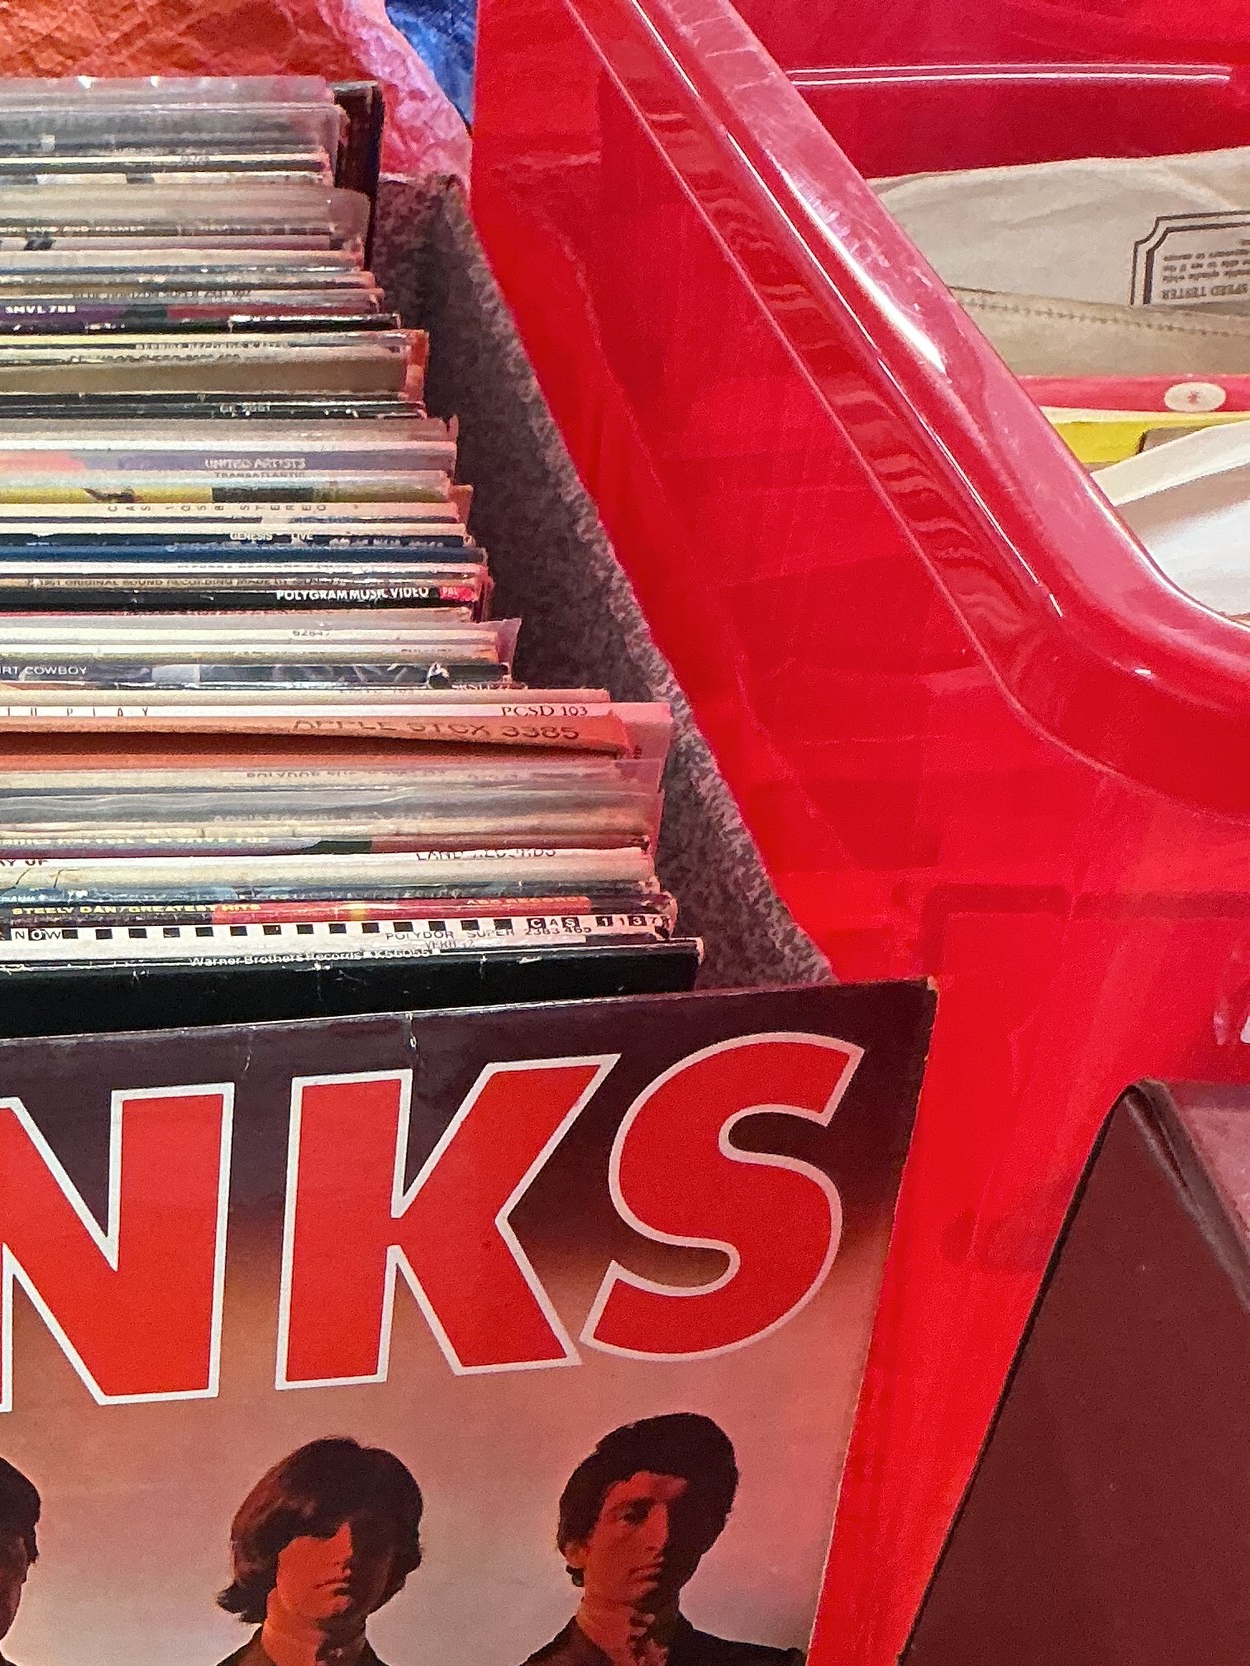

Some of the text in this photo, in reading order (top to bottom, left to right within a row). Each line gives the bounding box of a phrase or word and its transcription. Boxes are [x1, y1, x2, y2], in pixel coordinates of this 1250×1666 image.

[253, 458, 307, 470] ARTISTS
[275, 589, 348, 601] POLYGRAM
[349, 588, 389, 600] MUSIC
[390, 586, 430, 598] VIDEO
[23, 665, 88, 676] COWBOY
[500, 705, 556, 717] PCSD
[561, 705, 589, 717] 103
[501, 725, 581, 741] 3385
[11, 905, 76, 915] STEELY
[13, 928, 62, 942] NOW
[526, 917, 581, 929] CAS
[188, 955, 242, 968] Warner
[243, 953, 303, 964] Brothers
[305, 951, 362, 962] Records
